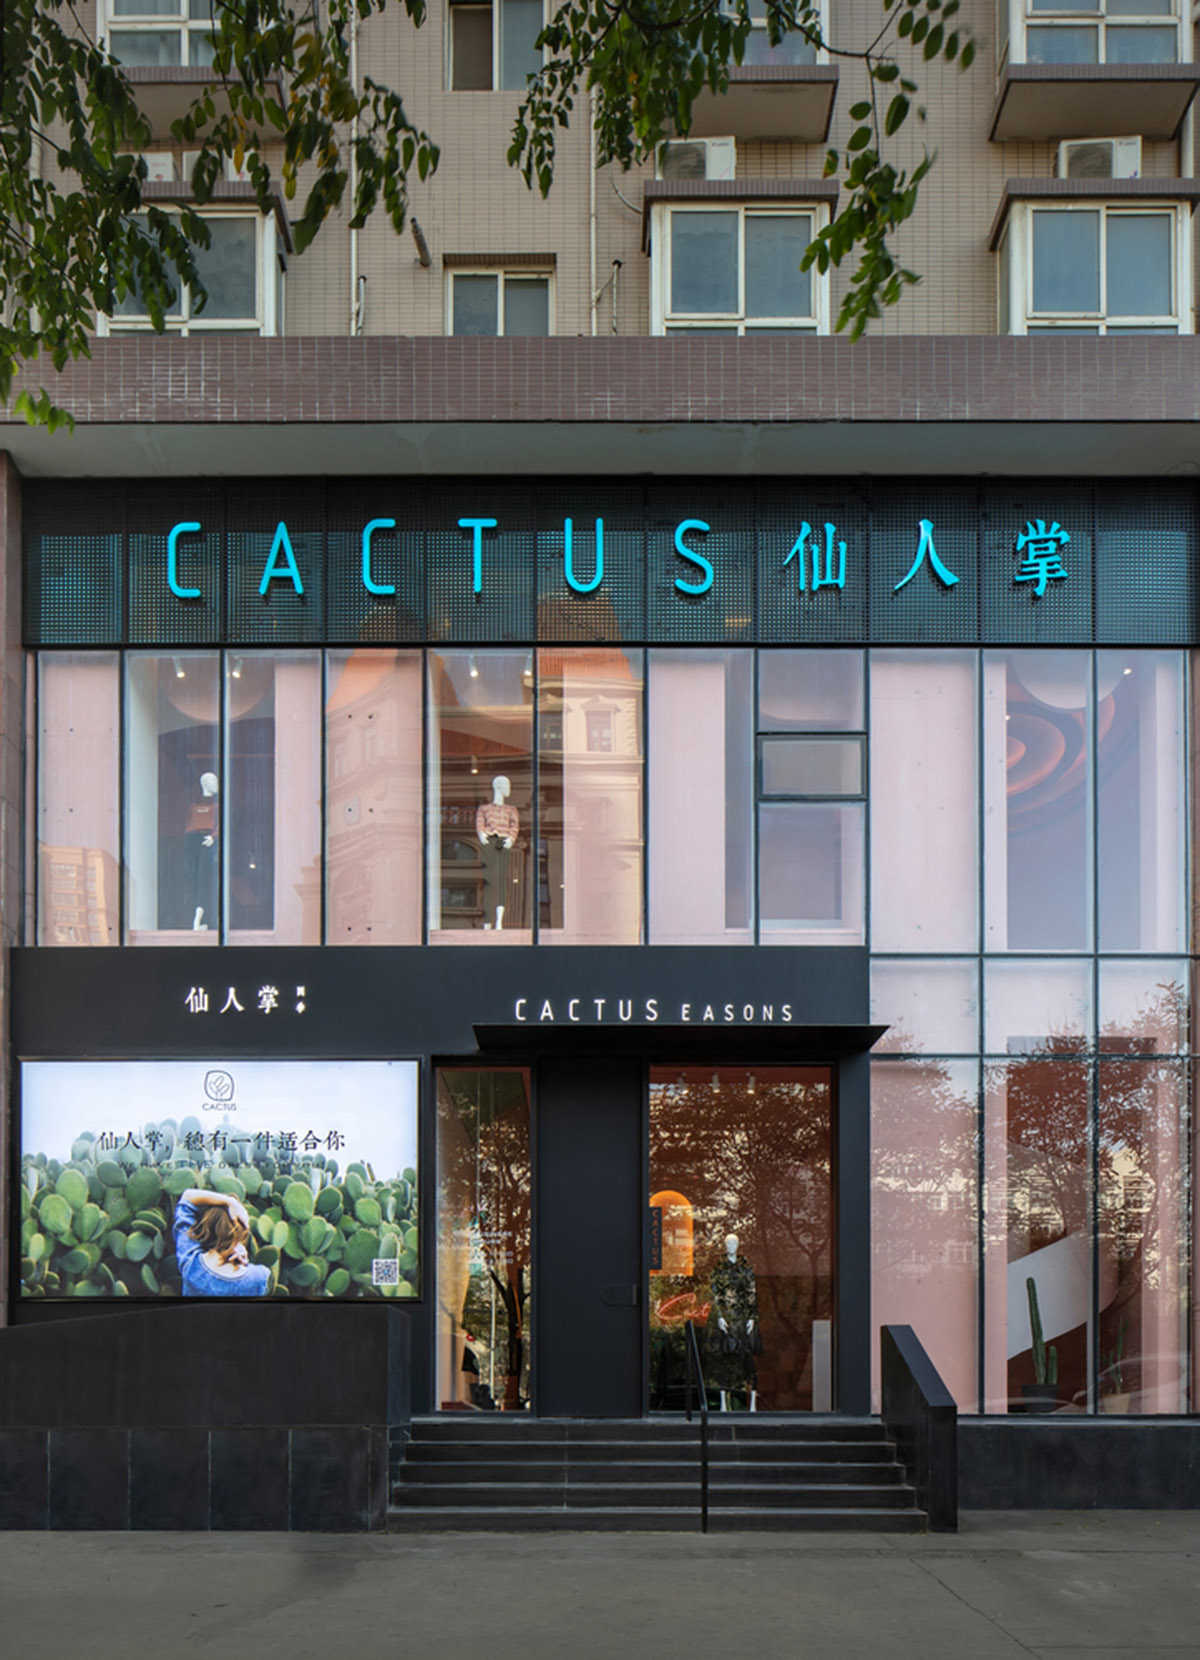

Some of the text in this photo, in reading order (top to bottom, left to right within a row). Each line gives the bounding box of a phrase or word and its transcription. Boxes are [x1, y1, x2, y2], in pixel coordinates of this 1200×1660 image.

[167, 517, 1071, 598] CACTUS 仙人掌
[184, 984, 279, 1015] 仙人掌
[514, 998, 793, 1022] CACTUS EASONS
[202, 1103, 237, 1111] CACTUS
